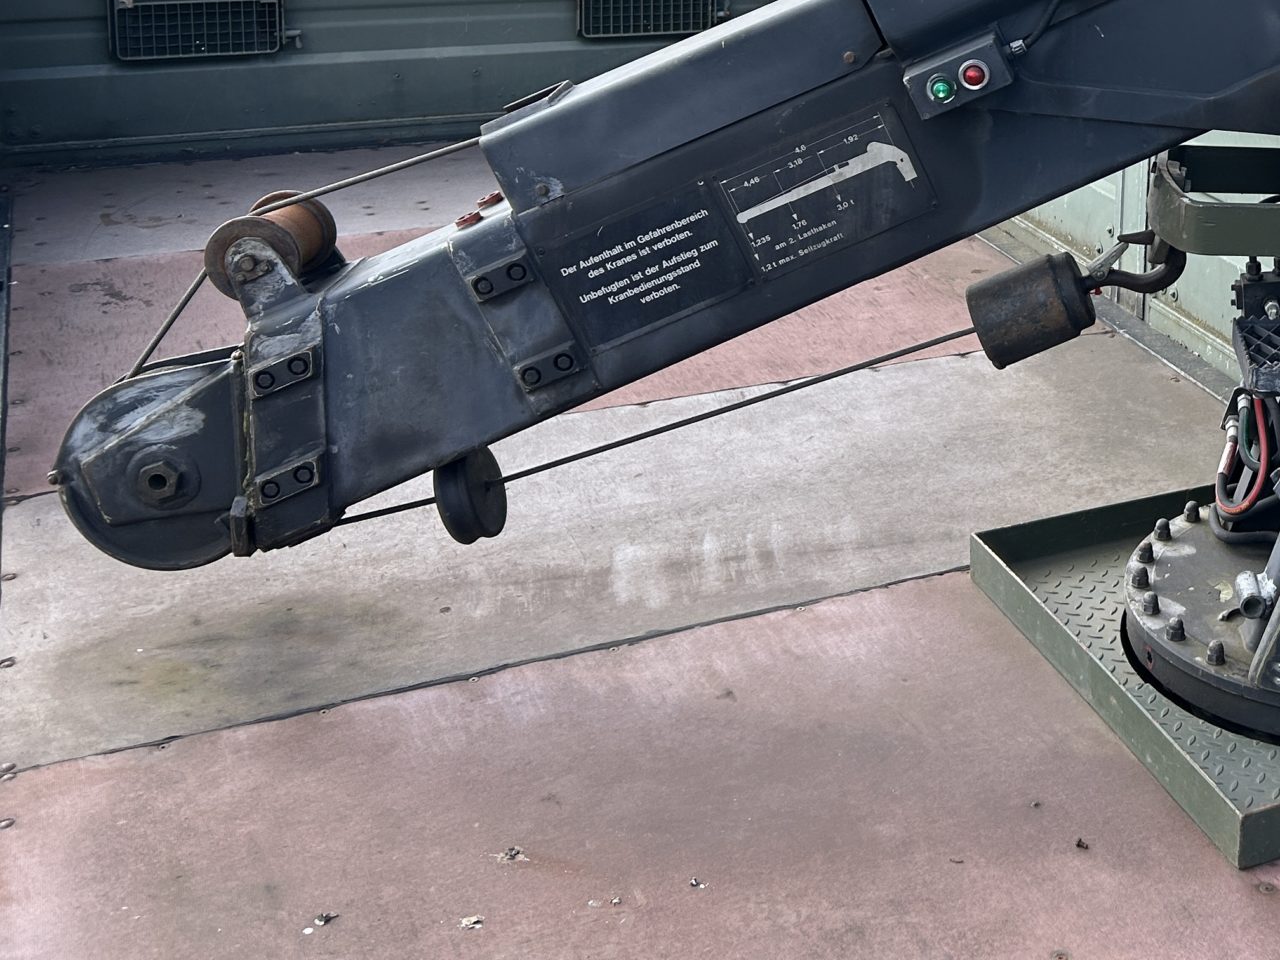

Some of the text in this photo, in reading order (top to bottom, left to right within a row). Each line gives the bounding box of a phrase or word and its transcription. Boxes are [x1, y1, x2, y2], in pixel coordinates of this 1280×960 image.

[843, 134, 859, 144] 1,92
[836, 202, 848, 211] 3,0
[774, 241, 787, 250] am
[797, 220, 837, 240] Lasthaken
[791, 219, 807, 230] 1,76
[560, 208, 709, 277] Der Aufenthalt im Gefahrenbereich
[587, 231, 693, 278] des Kranes ist verboten.
[751, 234, 771, 247] 1,235
[779, 255, 797, 265] max.
[798, 232, 844, 256] Seilzugkraft
[579, 239, 719, 304] Unbefugten ist der Aufstieg zum
[608, 259, 701, 305] Kranbedienungsstand
[640, 283, 681, 304] verboten.
